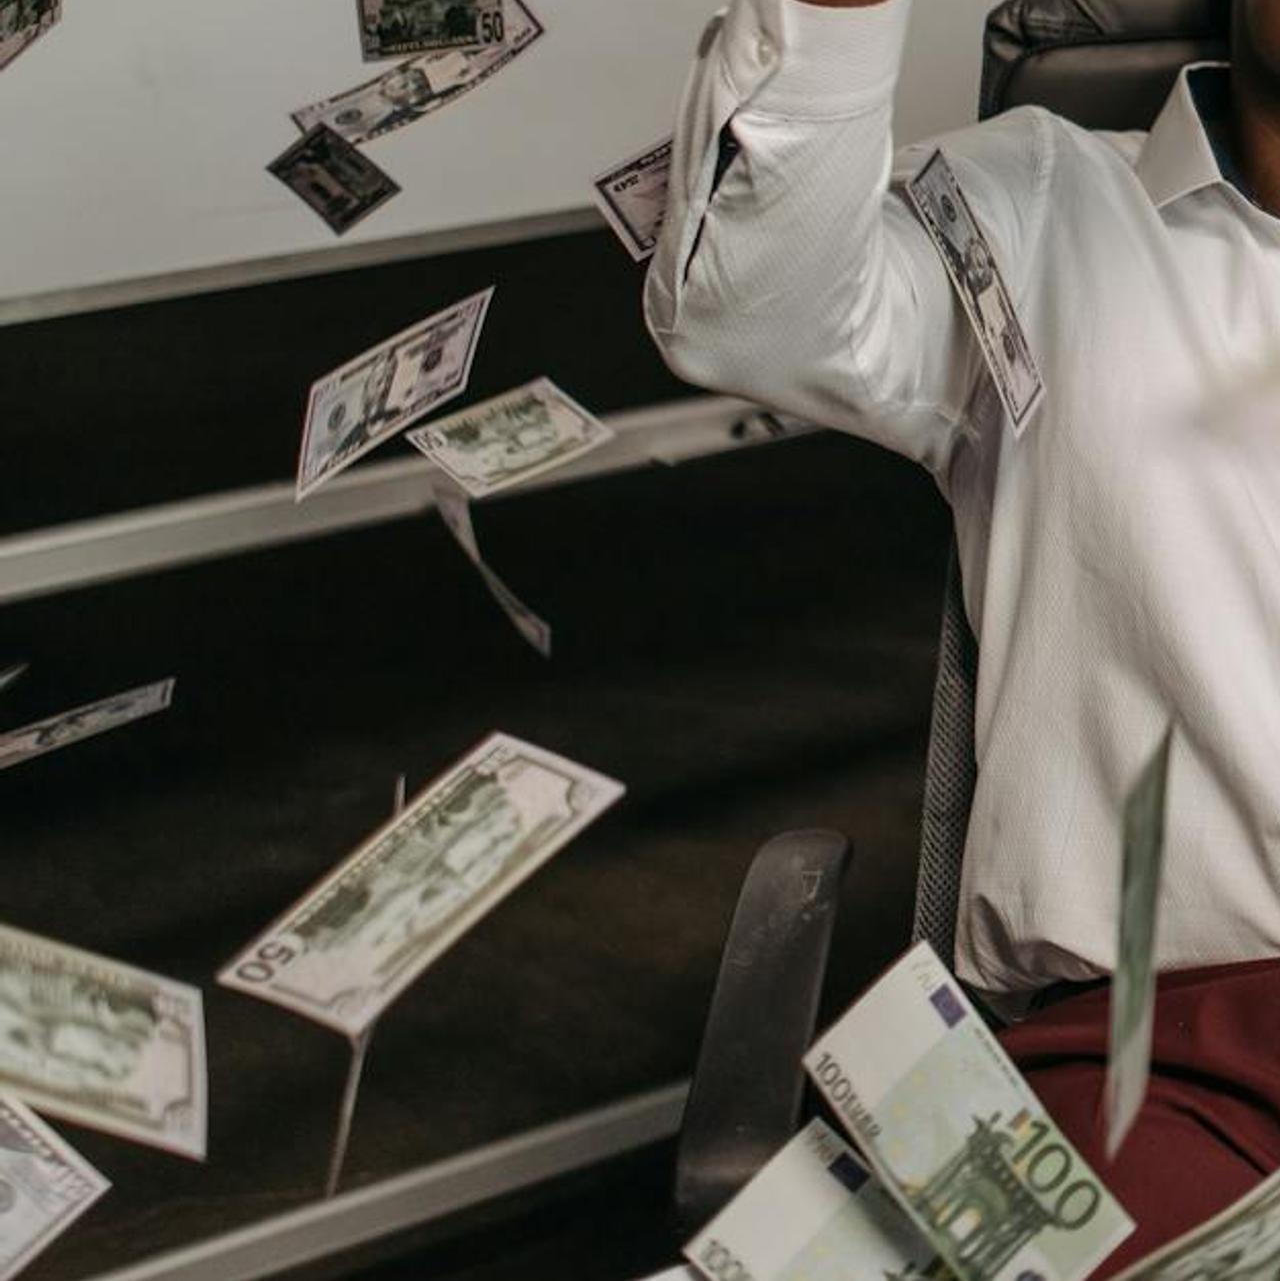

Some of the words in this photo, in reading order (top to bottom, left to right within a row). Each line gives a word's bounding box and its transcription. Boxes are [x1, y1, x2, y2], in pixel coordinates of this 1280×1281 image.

[480, 11, 504, 44] 50
[235, 939, 296, 984] 50
[814, 1052, 852, 1102] 100
[1012, 1119, 1103, 1230] 100
